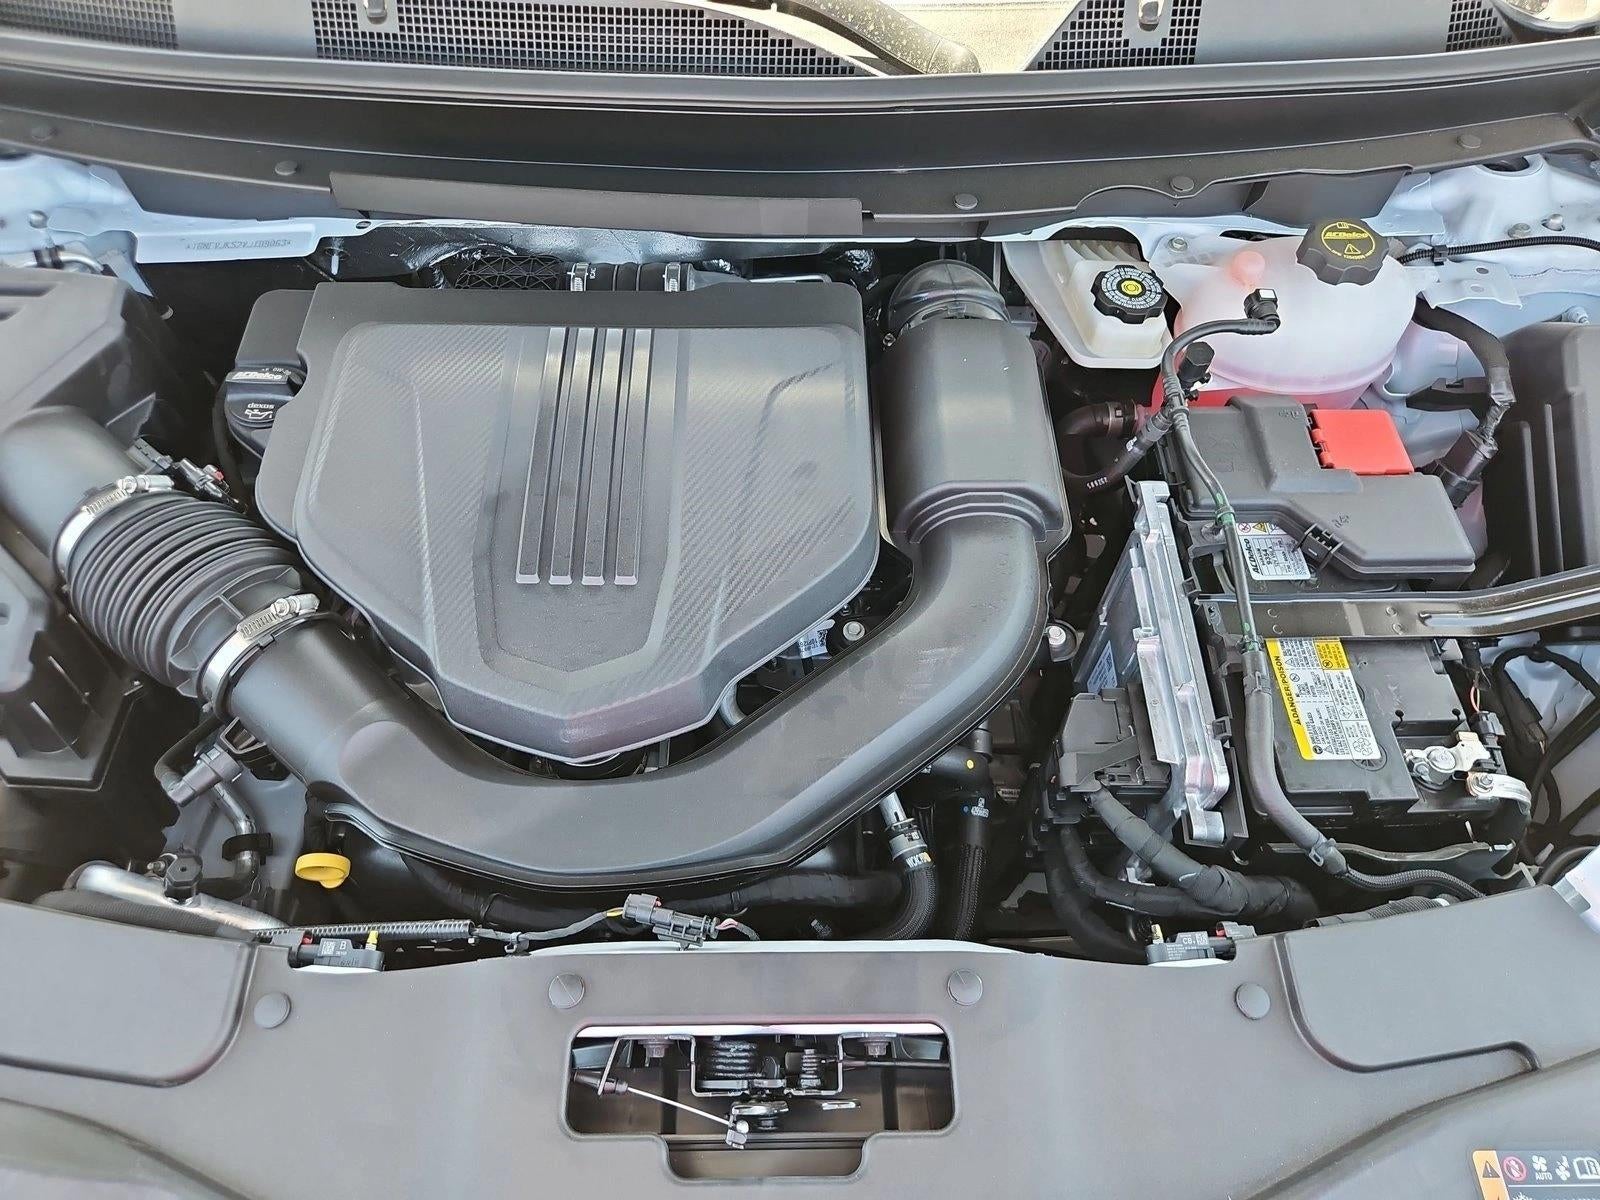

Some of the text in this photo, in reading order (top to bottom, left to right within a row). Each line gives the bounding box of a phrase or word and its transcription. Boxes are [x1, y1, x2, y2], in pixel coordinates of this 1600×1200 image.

[1324, 231, 1369, 239] ACDelco
[232, 371, 282, 380] ACDelco
[1243, 538, 1260, 574] ACDelco
[1535, 1172, 1553, 1181] AUTO
